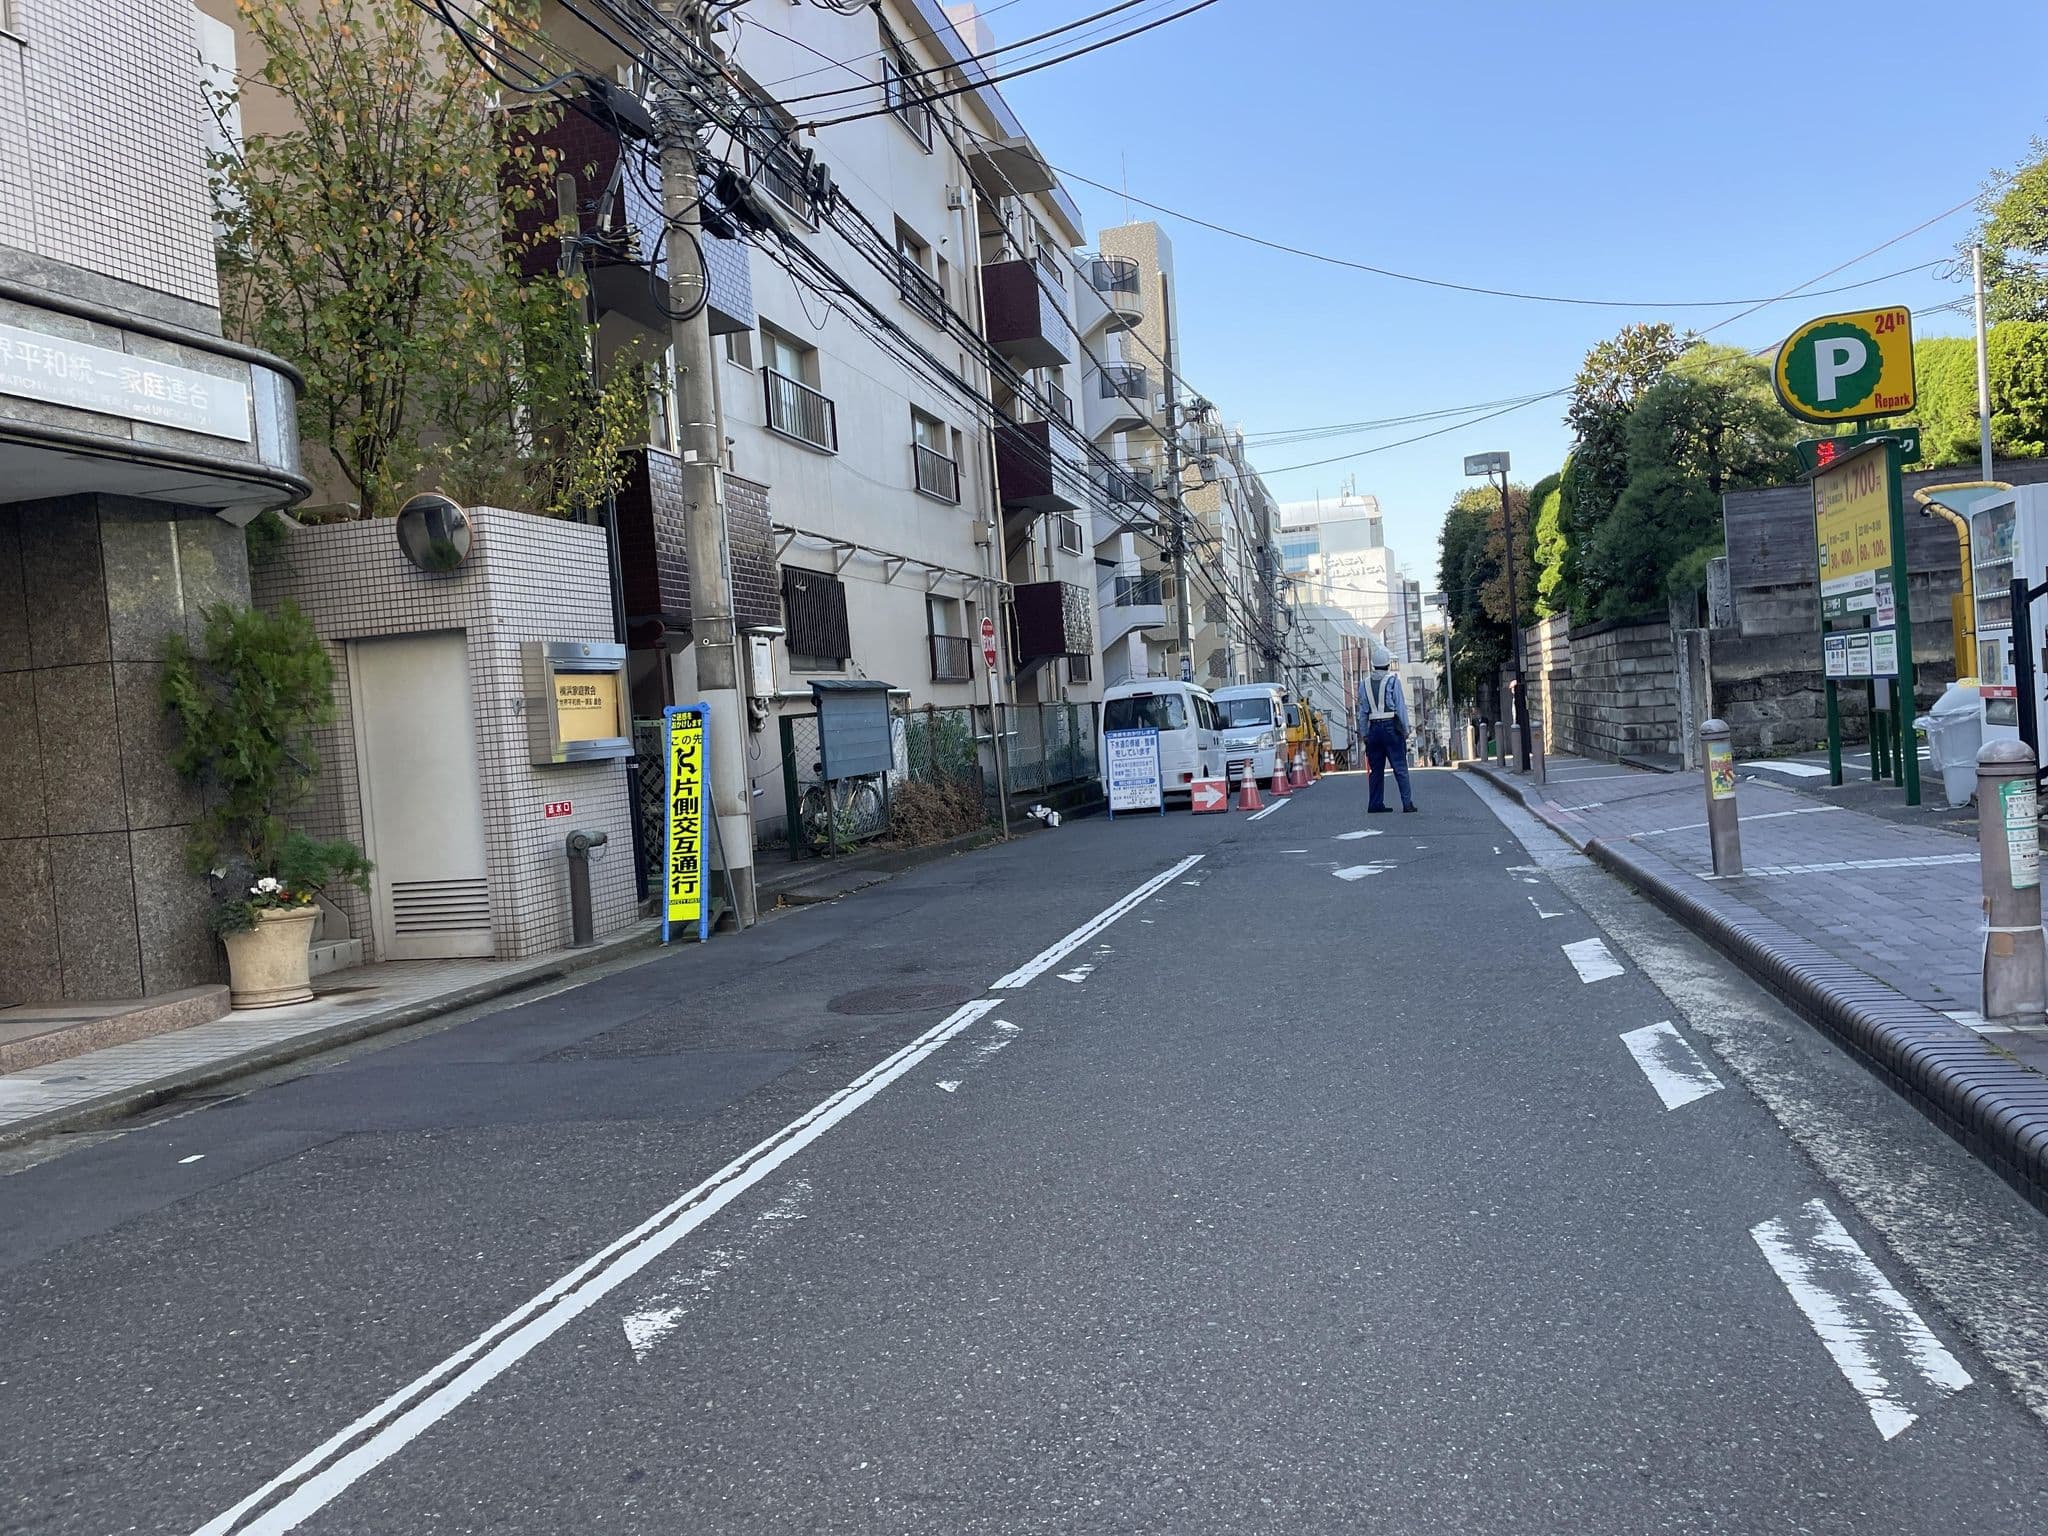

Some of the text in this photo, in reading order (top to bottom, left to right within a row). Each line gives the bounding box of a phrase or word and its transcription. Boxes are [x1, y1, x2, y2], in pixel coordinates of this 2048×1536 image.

[1874, 312, 1905, 335] 24h
[1814, 336, 1867, 402] P
[1874, 393, 1910, 409] Repark
[671, 718, 702, 729] おかけします
[671, 733, 703, 746] この先
[671, 777, 699, 895] 片側交互通行
